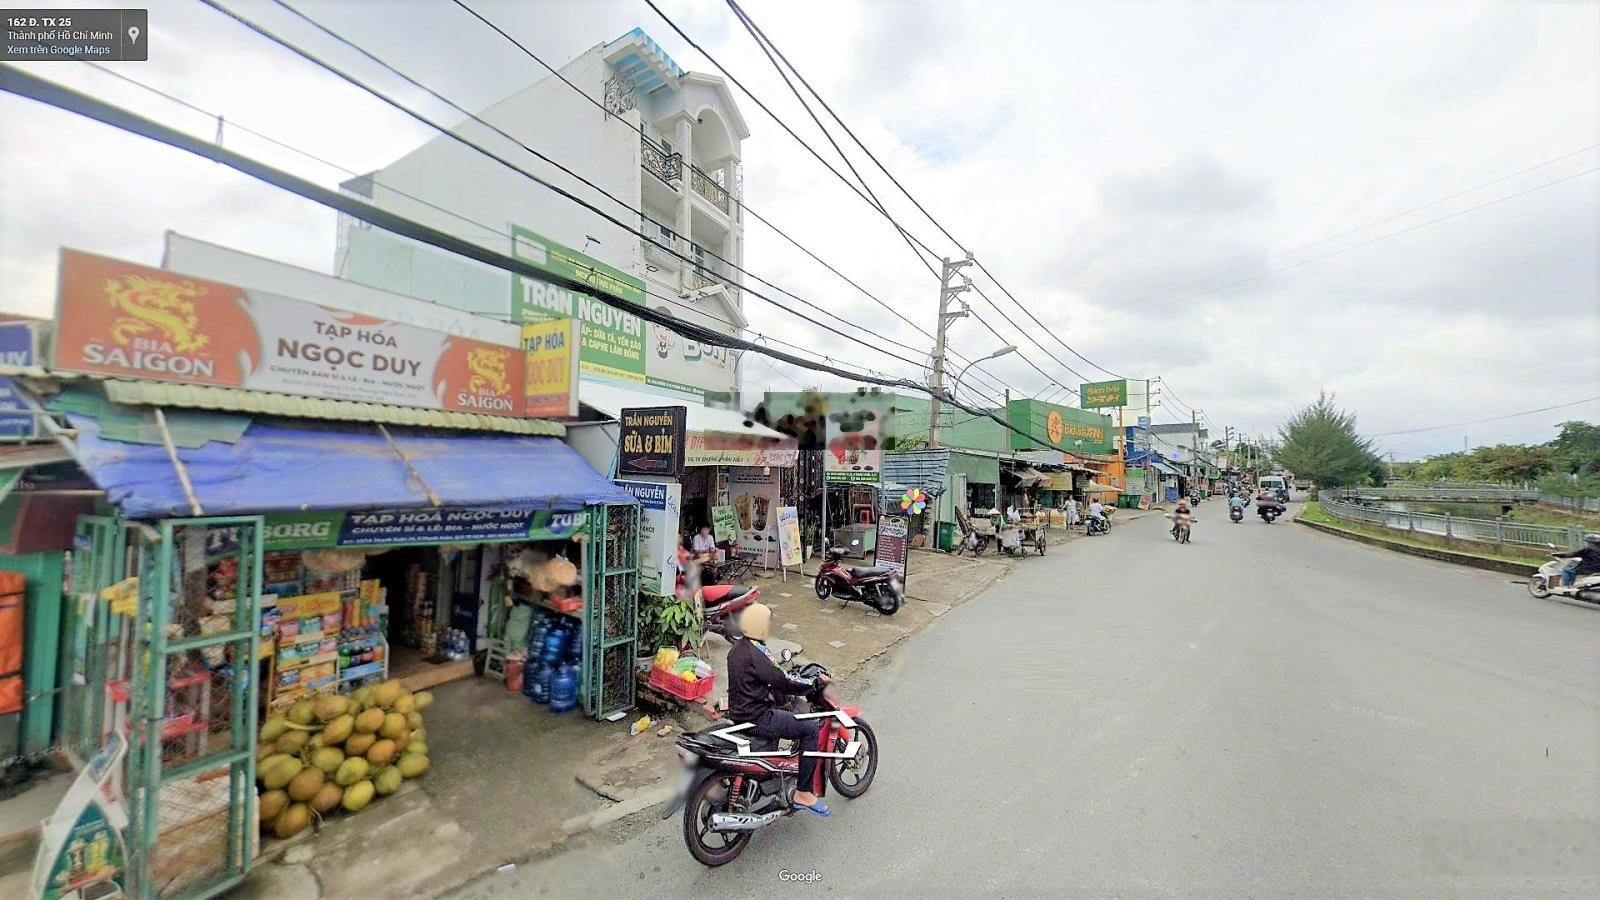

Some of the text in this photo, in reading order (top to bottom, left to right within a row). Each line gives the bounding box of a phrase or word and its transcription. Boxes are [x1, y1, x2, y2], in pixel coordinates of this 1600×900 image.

[132, 336, 173, 353] BIA
[313, 320, 351, 341] TẠP
[356, 330, 398, 348] HÓA
[277, 337, 422, 377] NGỌC DUY
[524, 336, 542, 356] TẠP
[83, 343, 215, 377] SAIGON
[457, 392, 513, 411] SAIGON
[624, 430, 643, 453] SỮA
[645, 435, 653, 453] &
[654, 428, 673, 453] BỈM
[634, 485, 665, 499] NGUYỄN
